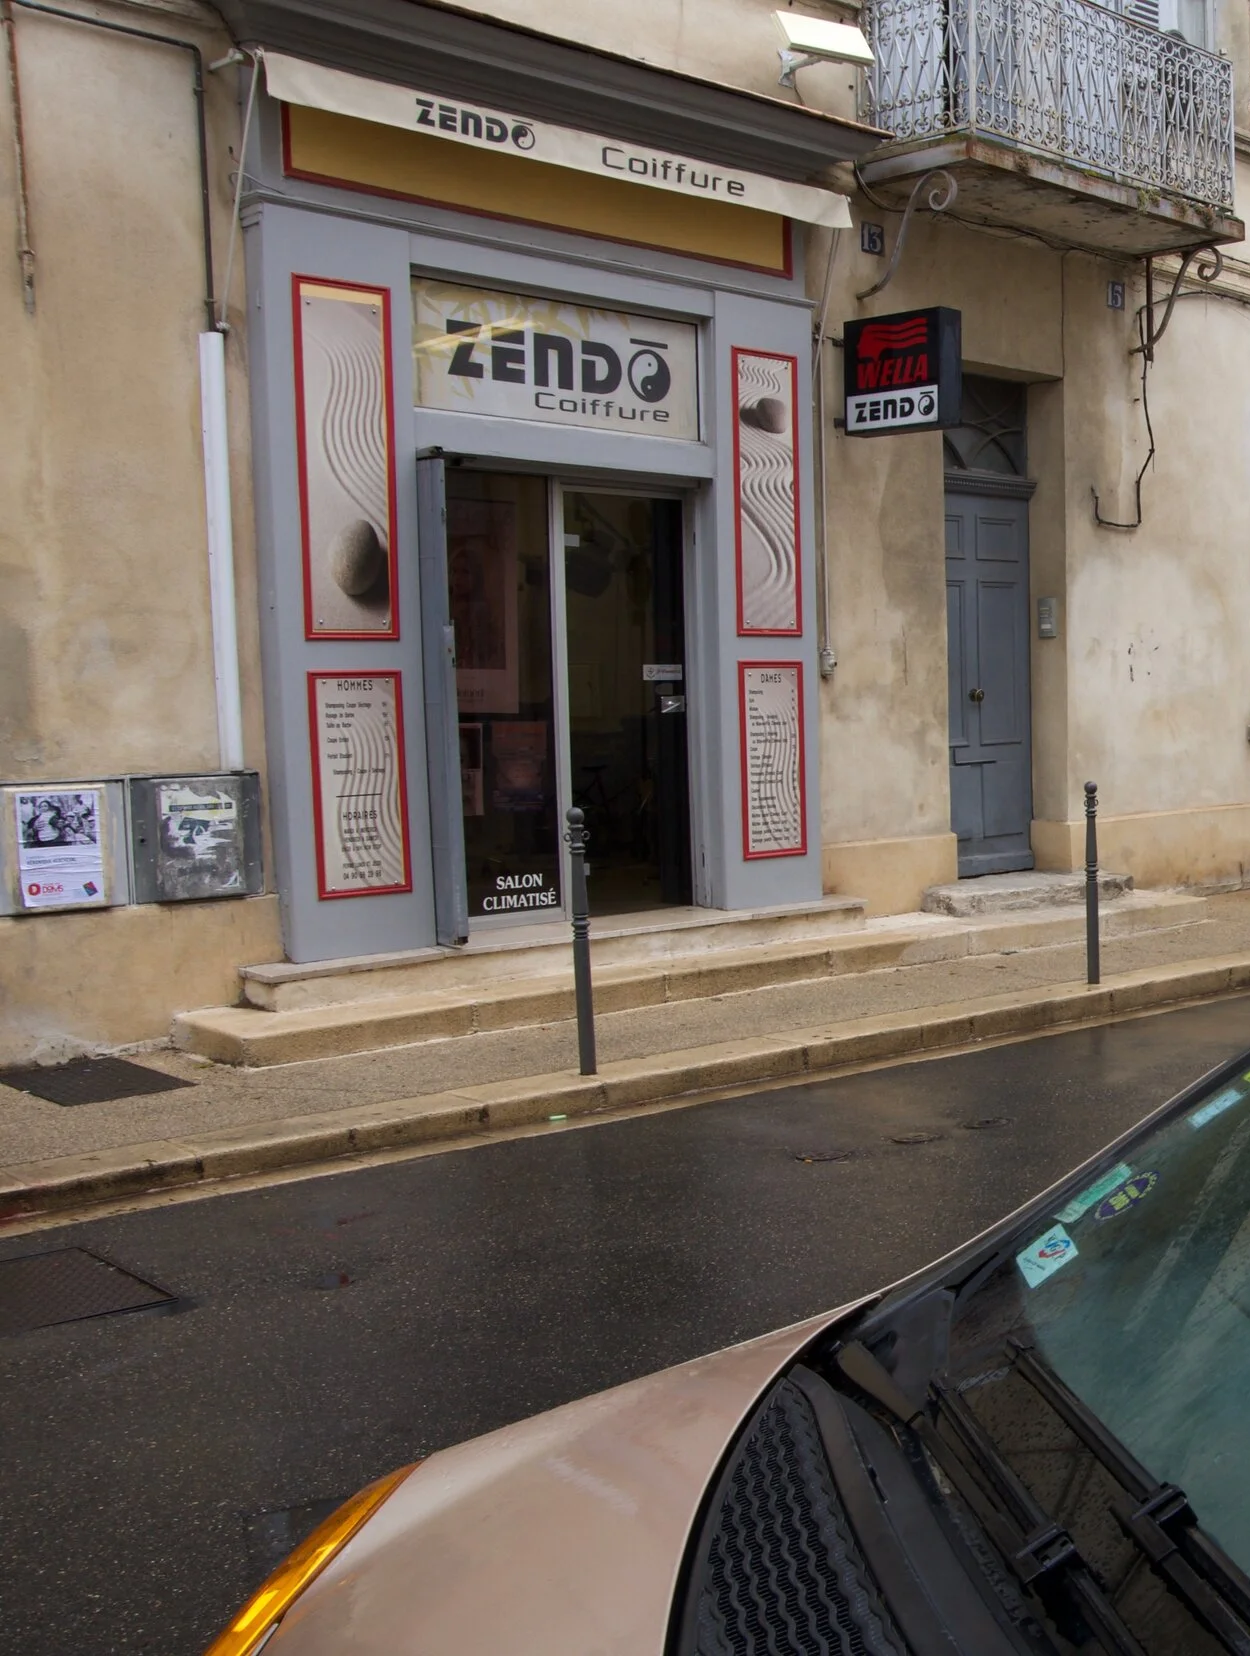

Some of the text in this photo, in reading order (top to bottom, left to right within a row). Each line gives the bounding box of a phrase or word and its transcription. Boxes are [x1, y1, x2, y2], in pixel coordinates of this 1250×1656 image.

[600, 145, 746, 198] Coiffure
[856, 353, 928, 390] WELLA
[533, 391, 671, 424] Coiffure
[337, 679, 374, 691] HOMMES
[760, 673, 782, 683] DAMES
[343, 810, 378, 821] HORAIRES
[496, 873, 543, 890] SALON
[483, 887, 557, 911] CLIMATISÉ
